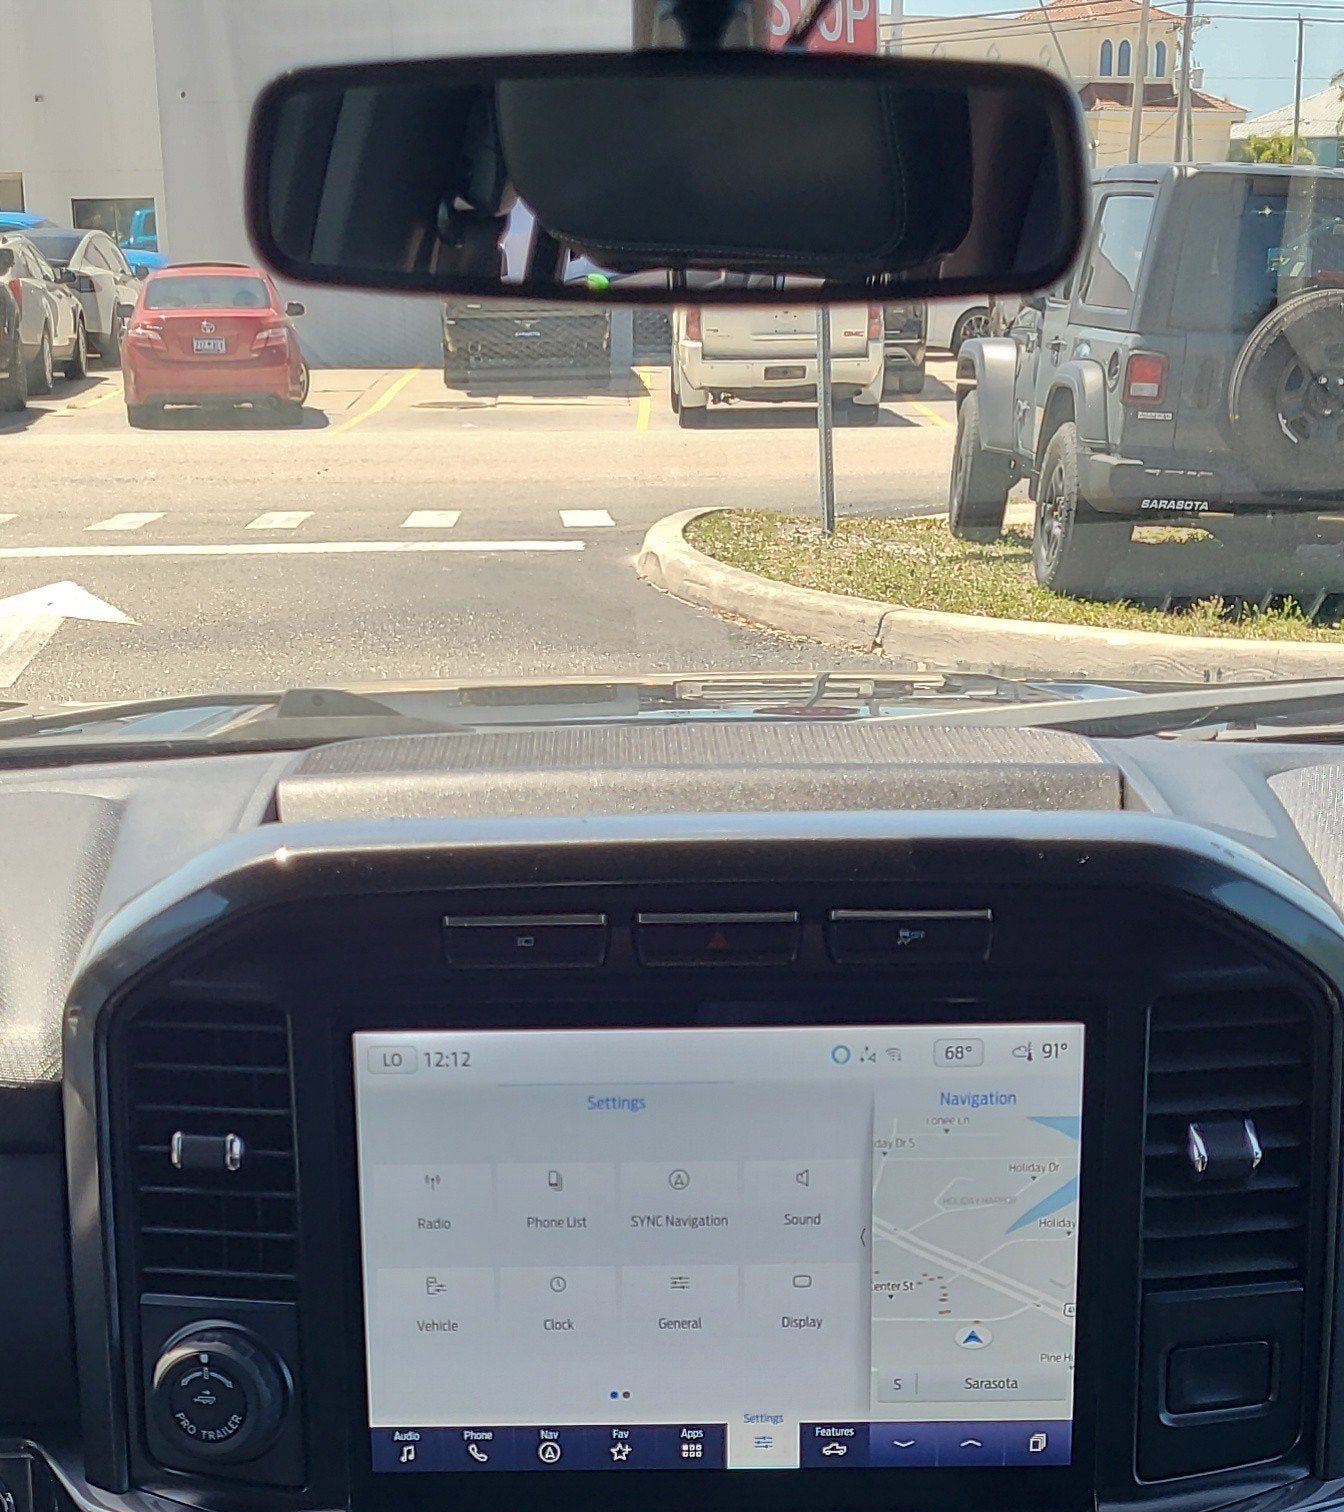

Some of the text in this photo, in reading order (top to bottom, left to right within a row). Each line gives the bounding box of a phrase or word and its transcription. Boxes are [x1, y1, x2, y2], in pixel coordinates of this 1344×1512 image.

[769, 0, 870, 43] SOP
[1141, 499, 1209, 510] SARASOTA
[945, 1045, 973, 1060] 68°
[1042, 1043, 1068, 1059] 91°
[383, 1054, 403, 1068] LO
[423, 1052, 472, 1068] 12:12
[587, 1095, 646, 1112] Settings
[939, 1091, 1017, 1108] Navigation
[1009, 1162, 1059, 1174] Holiday Dr
[417, 1218, 451, 1229] Radio
[527, 1217, 587, 1228] Phone List
[631, 1215, 729, 1229] SYNC Navigation
[784, 1213, 821, 1226] Sound
[903, 1281, 913, 1290] St
[417, 1320, 458, 1332] Vehicle
[543, 1319, 574, 1331] Clock
[658, 1317, 702, 1329] General
[781, 1316, 822, 1330] Display
[1040, 1353, 1061, 1362] Pine
[894, 1379, 902, 1390] S
[965, 1378, 1018, 1389] Sarasota
[743, 1413, 784, 1424] Settings
[175, 1412, 243, 1440] PRO TRAILER
[815, 1427, 854, 1437] Features
[393, 1431, 420, 1442] Audio
[464, 1430, 493, 1441] Phone
[540, 1430, 559, 1440] Nav
[612, 1429, 629, 1440] Fav
[681, 1428, 704, 1441] Apps
